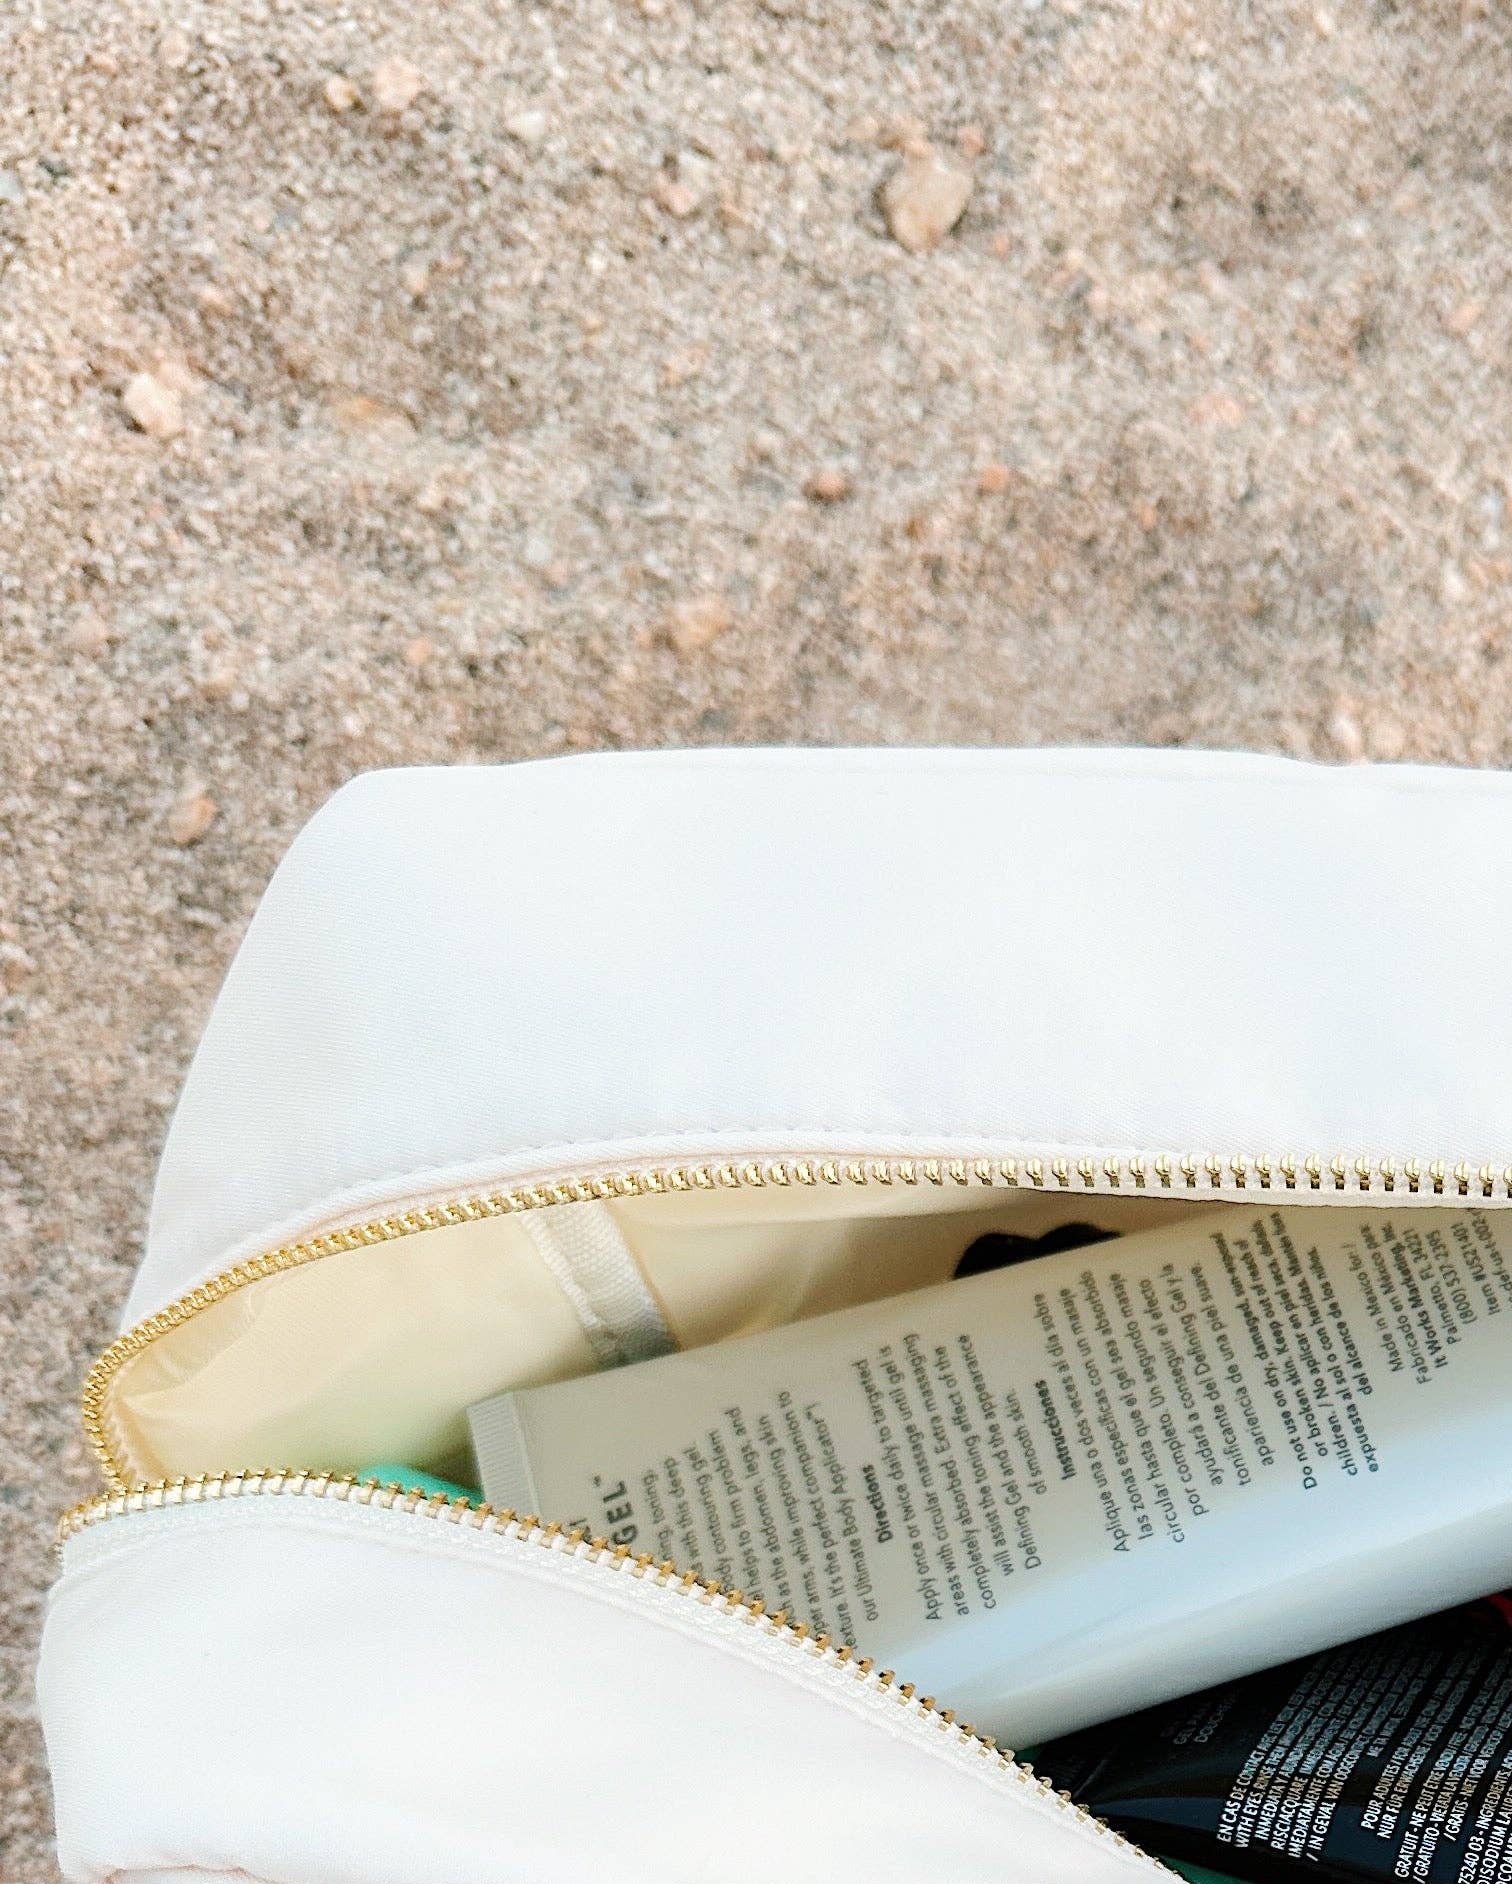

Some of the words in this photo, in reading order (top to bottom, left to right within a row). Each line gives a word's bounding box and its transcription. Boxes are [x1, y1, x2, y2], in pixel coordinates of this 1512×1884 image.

[1032, 1292, 1054, 1330] sobre
[1137, 1278, 1162, 1320] efecto
[1164, 1288, 1186, 1313] Gel
[1256, 1297, 1276, 1318] out
[1449, 1287, 1478, 1324] (800)
[1199, 1305, 1229, 1330] piel
[1374, 1317, 1388, 1330] in
[1416, 1309, 1442, 1354] Works
[877, 1345, 892, 1358] is
[1076, 1337, 1091, 1356] un
[1125, 1320, 1157, 1382] segundo
[1177, 1313, 1209, 1375] Defining
[1215, 1333, 1234, 1360] una
[1268, 1319, 1290, 1354] Keep
[1315, 1327, 1332, 1350] con
[1334, 1320, 1362, 1369] alcance
[1380, 1332, 1404, 1371] Made
[1396, 1314, 1431, 1383] Fabricado
[932, 1346, 951, 1371] the
[1051, 1359, 1069, 1372] al
[1293, 1333, 1322, 1375] aplicar
[880, 1360, 907, 1384] gel
[903, 1332, 938, 1412] massaging
[938, 1372, 957, 1388] of
[958, 1333, 998, 1420] appearance
[1083, 1359, 1101, 1385] con
[1109, 1367, 1137, 1389] gel
[1158, 1339, 1194, 1409] conseguir
[1225, 1363, 1243, 1384] de
[1326, 1364, 1346, 1384] sol
[1351, 1372, 1372, 1395] del
[777, 1390, 791, 1408] to
[852, 1358, 885, 1425] targeted
[1061, 1375, 1084, 1417] veces
[1148, 1385, 1166, 1407] Un
[1196, 1376, 1218, 1401] del
[1273, 1389, 1288, 1407] on
[1312, 1377, 1329, 1399] No
[1335, 1387, 1352, 1400] al
[888, 1387, 913, 1420] until
[945, 1391, 972, 1432] effect
[1294, 1388, 1321, 1438] broken
[725, 1407, 747, 1436] and
[756, 1415, 776, 1445] skin
[875, 1426, 891, 1443] to
[930, 1414, 951, 1453] Extra
[985, 1423, 1003, 1448] the
[1034, 1379, 1076, 1479] Instrucciones
[1075, 1418, 1093, 1446] dos
[1128, 1409, 1154, 1437] que
[1233, 1386, 1276, 1466] apariencia
[1281, 1410, 1298, 1433] use
[783, 1410, 817, 1494] companion
[1011, 1423, 1042, 1476] smooth
[1209, 1404, 1251, 1485] tonificante
[1287, 1437, 1308, 1461] not
[1313, 1441, 1328, 1457] or
[1344, 1403, 1378, 1472] expuesta
[707, 1429, 740, 1495] problem
[881, 1443, 902, 1482] daily
[905, 1423, 933, 1487] massage
[963, 1433, 987, 1484] toning
[991, 1449, 1013, 1477] and
[1085, 1448, 1098, 1459] o
[1138, 1439, 1163, 1479] hasta
[662, 1455, 683, 1499] deep
[768, 1446, 799, 1525] improving
[1029, 1478, 1047, 1494] of
[1089, 1460, 1107, 1487] una
[1121, 1467, 1144, 1510] zonas
[1300, 1465, 1317, 1489] Do
[862, 1463, 893, 1543] Directions
[894, 1483, 914, 1522] twice
[977, 1485, 995, 1509] the
[1000, 1480, 1021, 1505] Gel
[1184, 1485, 1210, 1515] por
[673, 1502, 691, 1529] this
[727, 1498, 744, 1528] firm
[806, 1498, 837, 1548] perfect
[837, 1496, 858, 1536] Body
[924, 1490, 948, 1541] circular
[1099, 1490, 1132, 1553] Aplique
[1136, 1514, 1153, 1539] las
[1155, 1481, 1185, 1543] circular
[735, 1530, 749, 1547] to
[906, 1524, 919, 1538] or
[982, 1509, 1006, 1547] assist
[1013, 1503, 1041, 1569] Defining
[679, 1529, 699, 1558] with
[790, 1526, 810, 1564] while
[911, 1541, 929, 1575] once
[935, 1543, 957, 1572] with
[741, 1547, 760, 1587] helps
[770, 1556, 786, 1580] the
[848, 1537, 872, 1596] Ultimate
[962, 1526, 996, 1609] completely
[993, 1549, 1014, 1575] will
[777, 1581, 790, 1596] as
[918, 1575, 944, 1622] Apply
[948, 1574, 968, 1616] areas
[864, 1597, 878, 1621] our
[1229, 1784, 1247, 1800] DE
[1324, 1778, 1344, 1801] VAN
[1371, 1762, 1400, 1799] ADULTES
[1222, 1799, 1241, 1824] CAS
[1254, 1782, 1285, 1840] INMEDIATA
[1271, 1774, 1308, 1850] RISCIACQUARE
[1361, 1798, 1383, 1829] POUR
[1385, 1791, 1405, 1813] FÜR
[1414, 1788, 1435, 1812] PEUT
[1444, 1798, 1468, 1834] GRATIS
[1458, 1776, 1478, 1796] NIET
[1286, 1776, 1326, 1858] IMEDIATAMENTE
[1312, 1798, 1336, 1835] GEVAL
[1377, 1811, 1397, 1838] NUR
[1409, 1810, 1426, 1827] NE
[1217, 1822, 1234, 1843] EN
[1233, 1815, 1254, 1849] WITH
[1308, 1834, 1324, 1850] IN
[1413, 1826, 1440, 1876] GRATUITO
[1429, 1789, 1454, 1824] VIETATA
[1467, 1835, 1485, 1851] 03
[1394, 1831, 1419, 1878] GRATUIT
